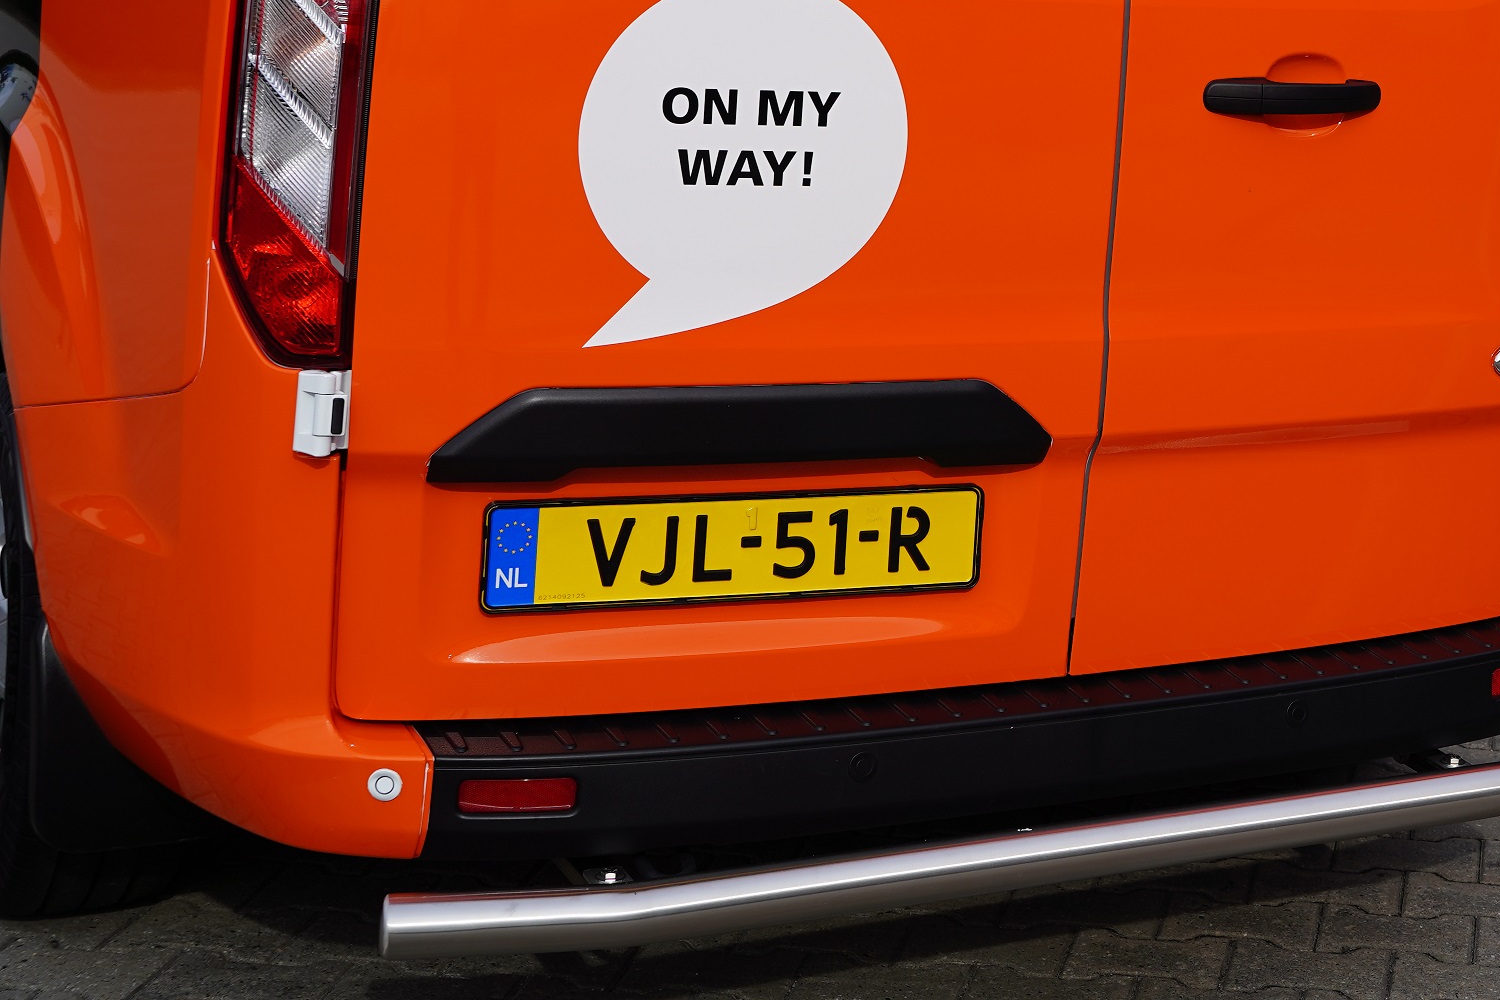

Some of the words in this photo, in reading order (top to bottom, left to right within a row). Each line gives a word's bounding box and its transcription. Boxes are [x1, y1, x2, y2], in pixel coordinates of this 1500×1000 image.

[662, 87, 738, 125] ON
[757, 90, 841, 127] MY
[678, 149, 814, 187] WAY!
[495, 567, 528, 589] NL
[586, 506, 931, 587] VJL-51-R
